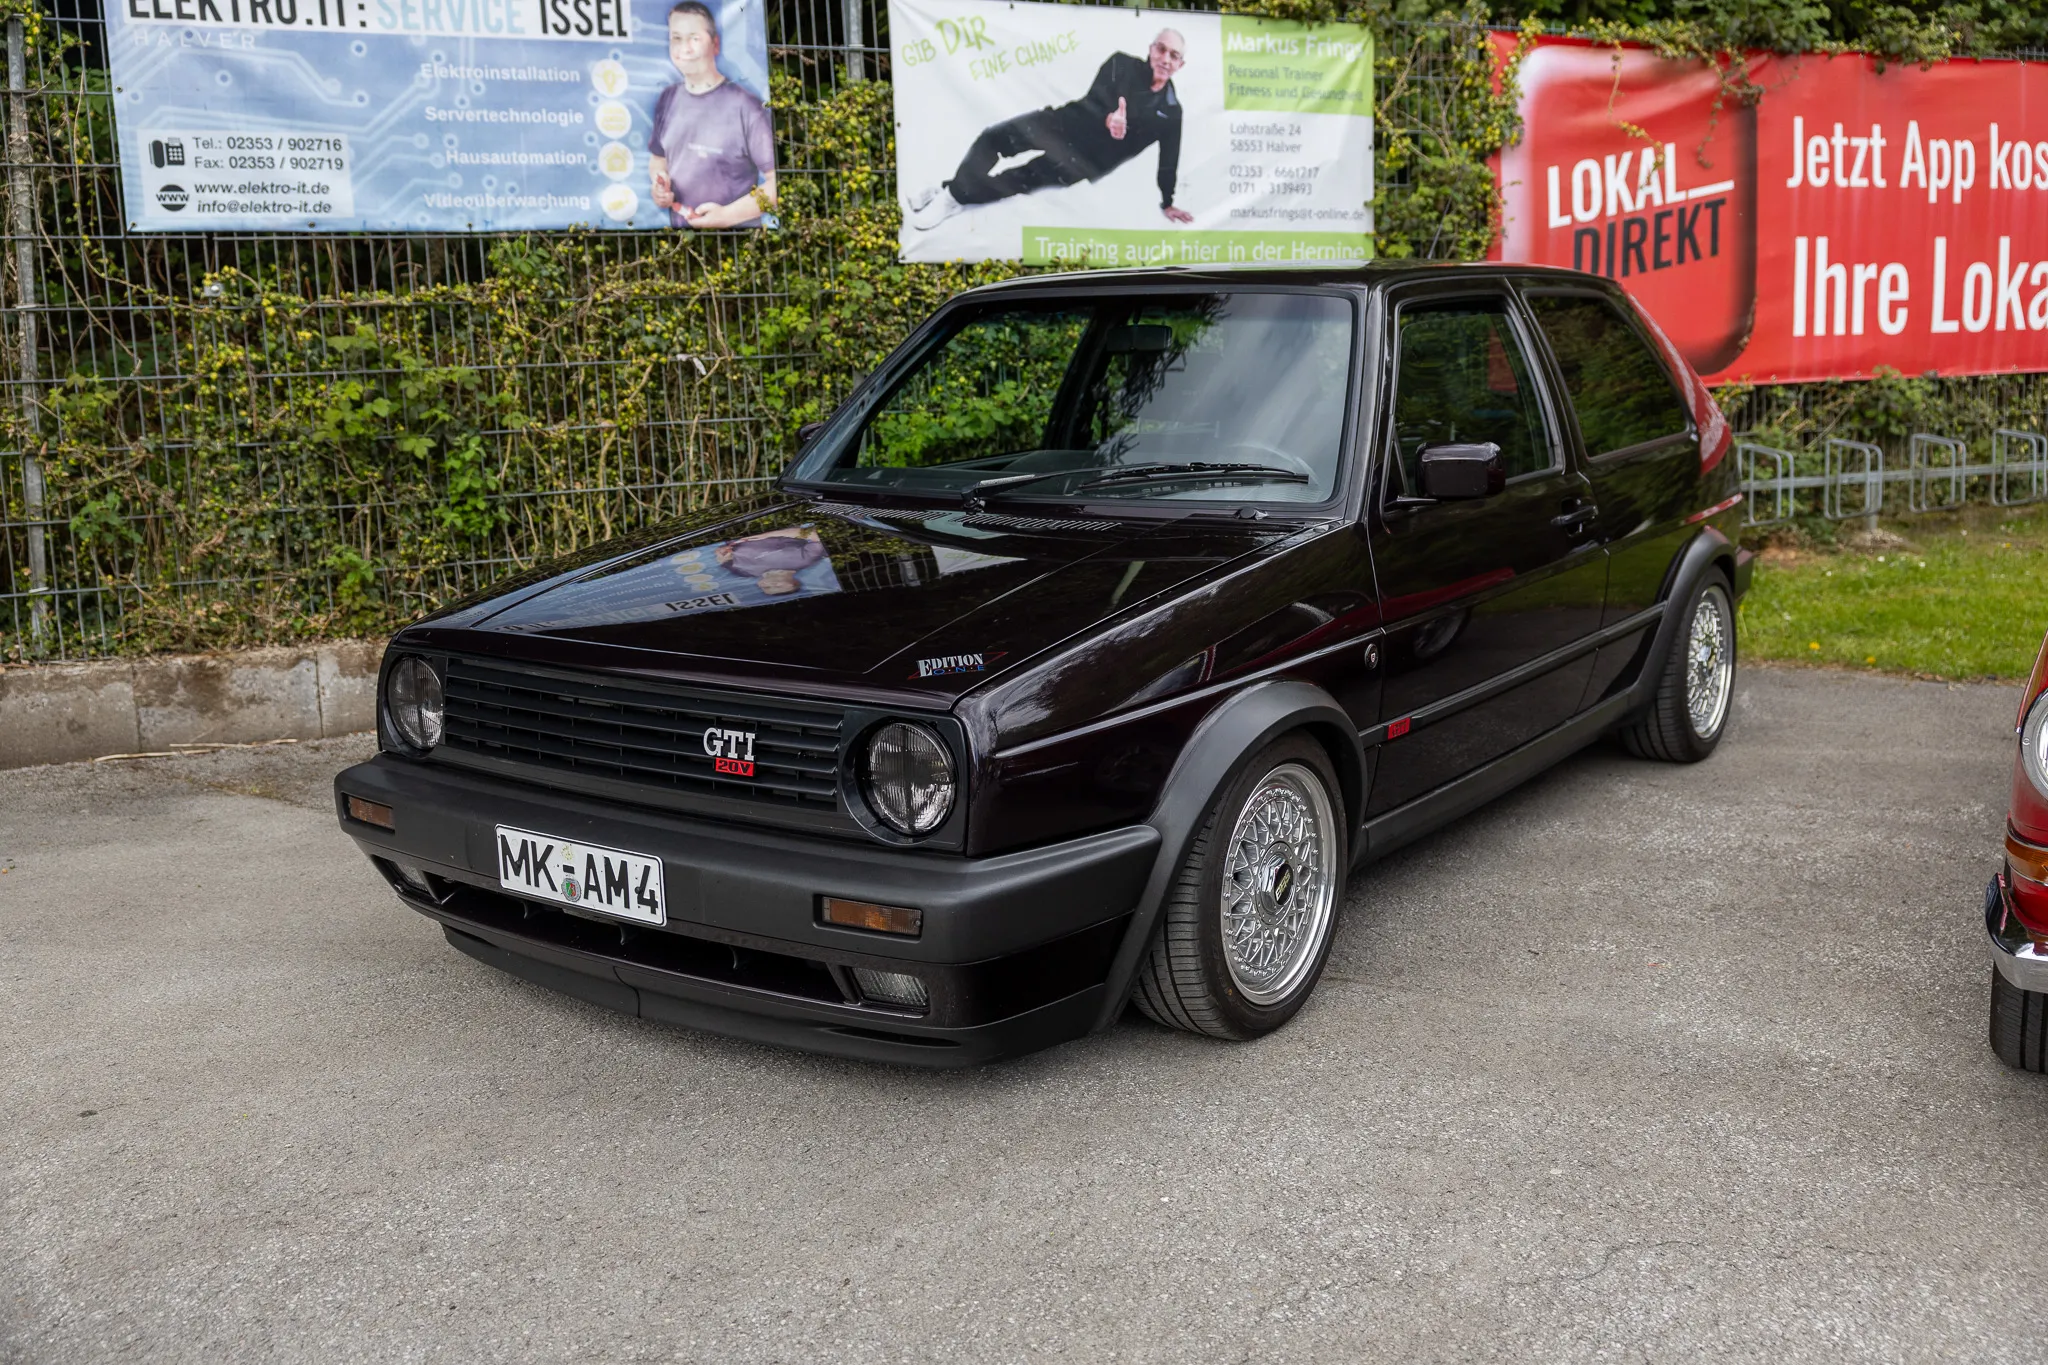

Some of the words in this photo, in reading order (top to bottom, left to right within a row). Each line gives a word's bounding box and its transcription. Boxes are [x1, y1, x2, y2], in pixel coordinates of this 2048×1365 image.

[377, 0, 525, 34] SERVICE
[540, 0, 628, 37] ISSEL
[134, 30, 256, 50] HALVER
[902, 38, 937, 67] GIB
[936, 16, 995, 55] DIR
[1227, 32, 1299, 55] Markus
[969, 50, 1011, 81] EINE
[1015, 30, 1081, 68] CHANCE
[420, 62, 580, 83] Elektroinstallation
[1228, 64, 1279, 79] Personal
[1284, 66, 1324, 82] Trainer
[1229, 83, 1272, 98] Fitness
[1276, 85, 1297, 98] und
[425, 106, 584, 127] Servertechnologie
[1230, 122, 1285, 136] Lohstraße
[1289, 123, 1302, 136] 24
[192, 136, 222, 150] Tel.:
[227, 136, 273, 150] 02353
[288, 138, 342, 151] 902716
[1230, 139, 1263, 153] 58553
[1266, 141, 1303, 153] Halver
[194, 156, 224, 169] Fax:
[229, 156, 275, 169] 02353
[290, 158, 344, 171] 902719
[446, 149, 588, 166] Hausautomation
[1787, 116, 1887, 189] Jetzt
[1900, 120, 1975, 204] App
[1229, 164, 1262, 178] 02353
[194, 181, 330, 196] www.elektro-it.de
[1229, 181, 1255, 194] 0171
[198, 199, 332, 214] info@elektro-it.de
[424, 192, 590, 211] Videoüberwachung
[1574, 198, 1727, 279] DIREKT
[1035, 235, 1118, 265] Training
[1125, 240, 1174, 261] auch
[1181, 239, 1221, 261] hier
[1229, 240, 1245, 261] in
[1252, 240, 1285, 261] der
[1793, 236, 1909, 337] Ihre
[917, 653, 983, 677] EDITION
[703, 727, 756, 761] GTI
[717, 759, 751, 775] 20V
